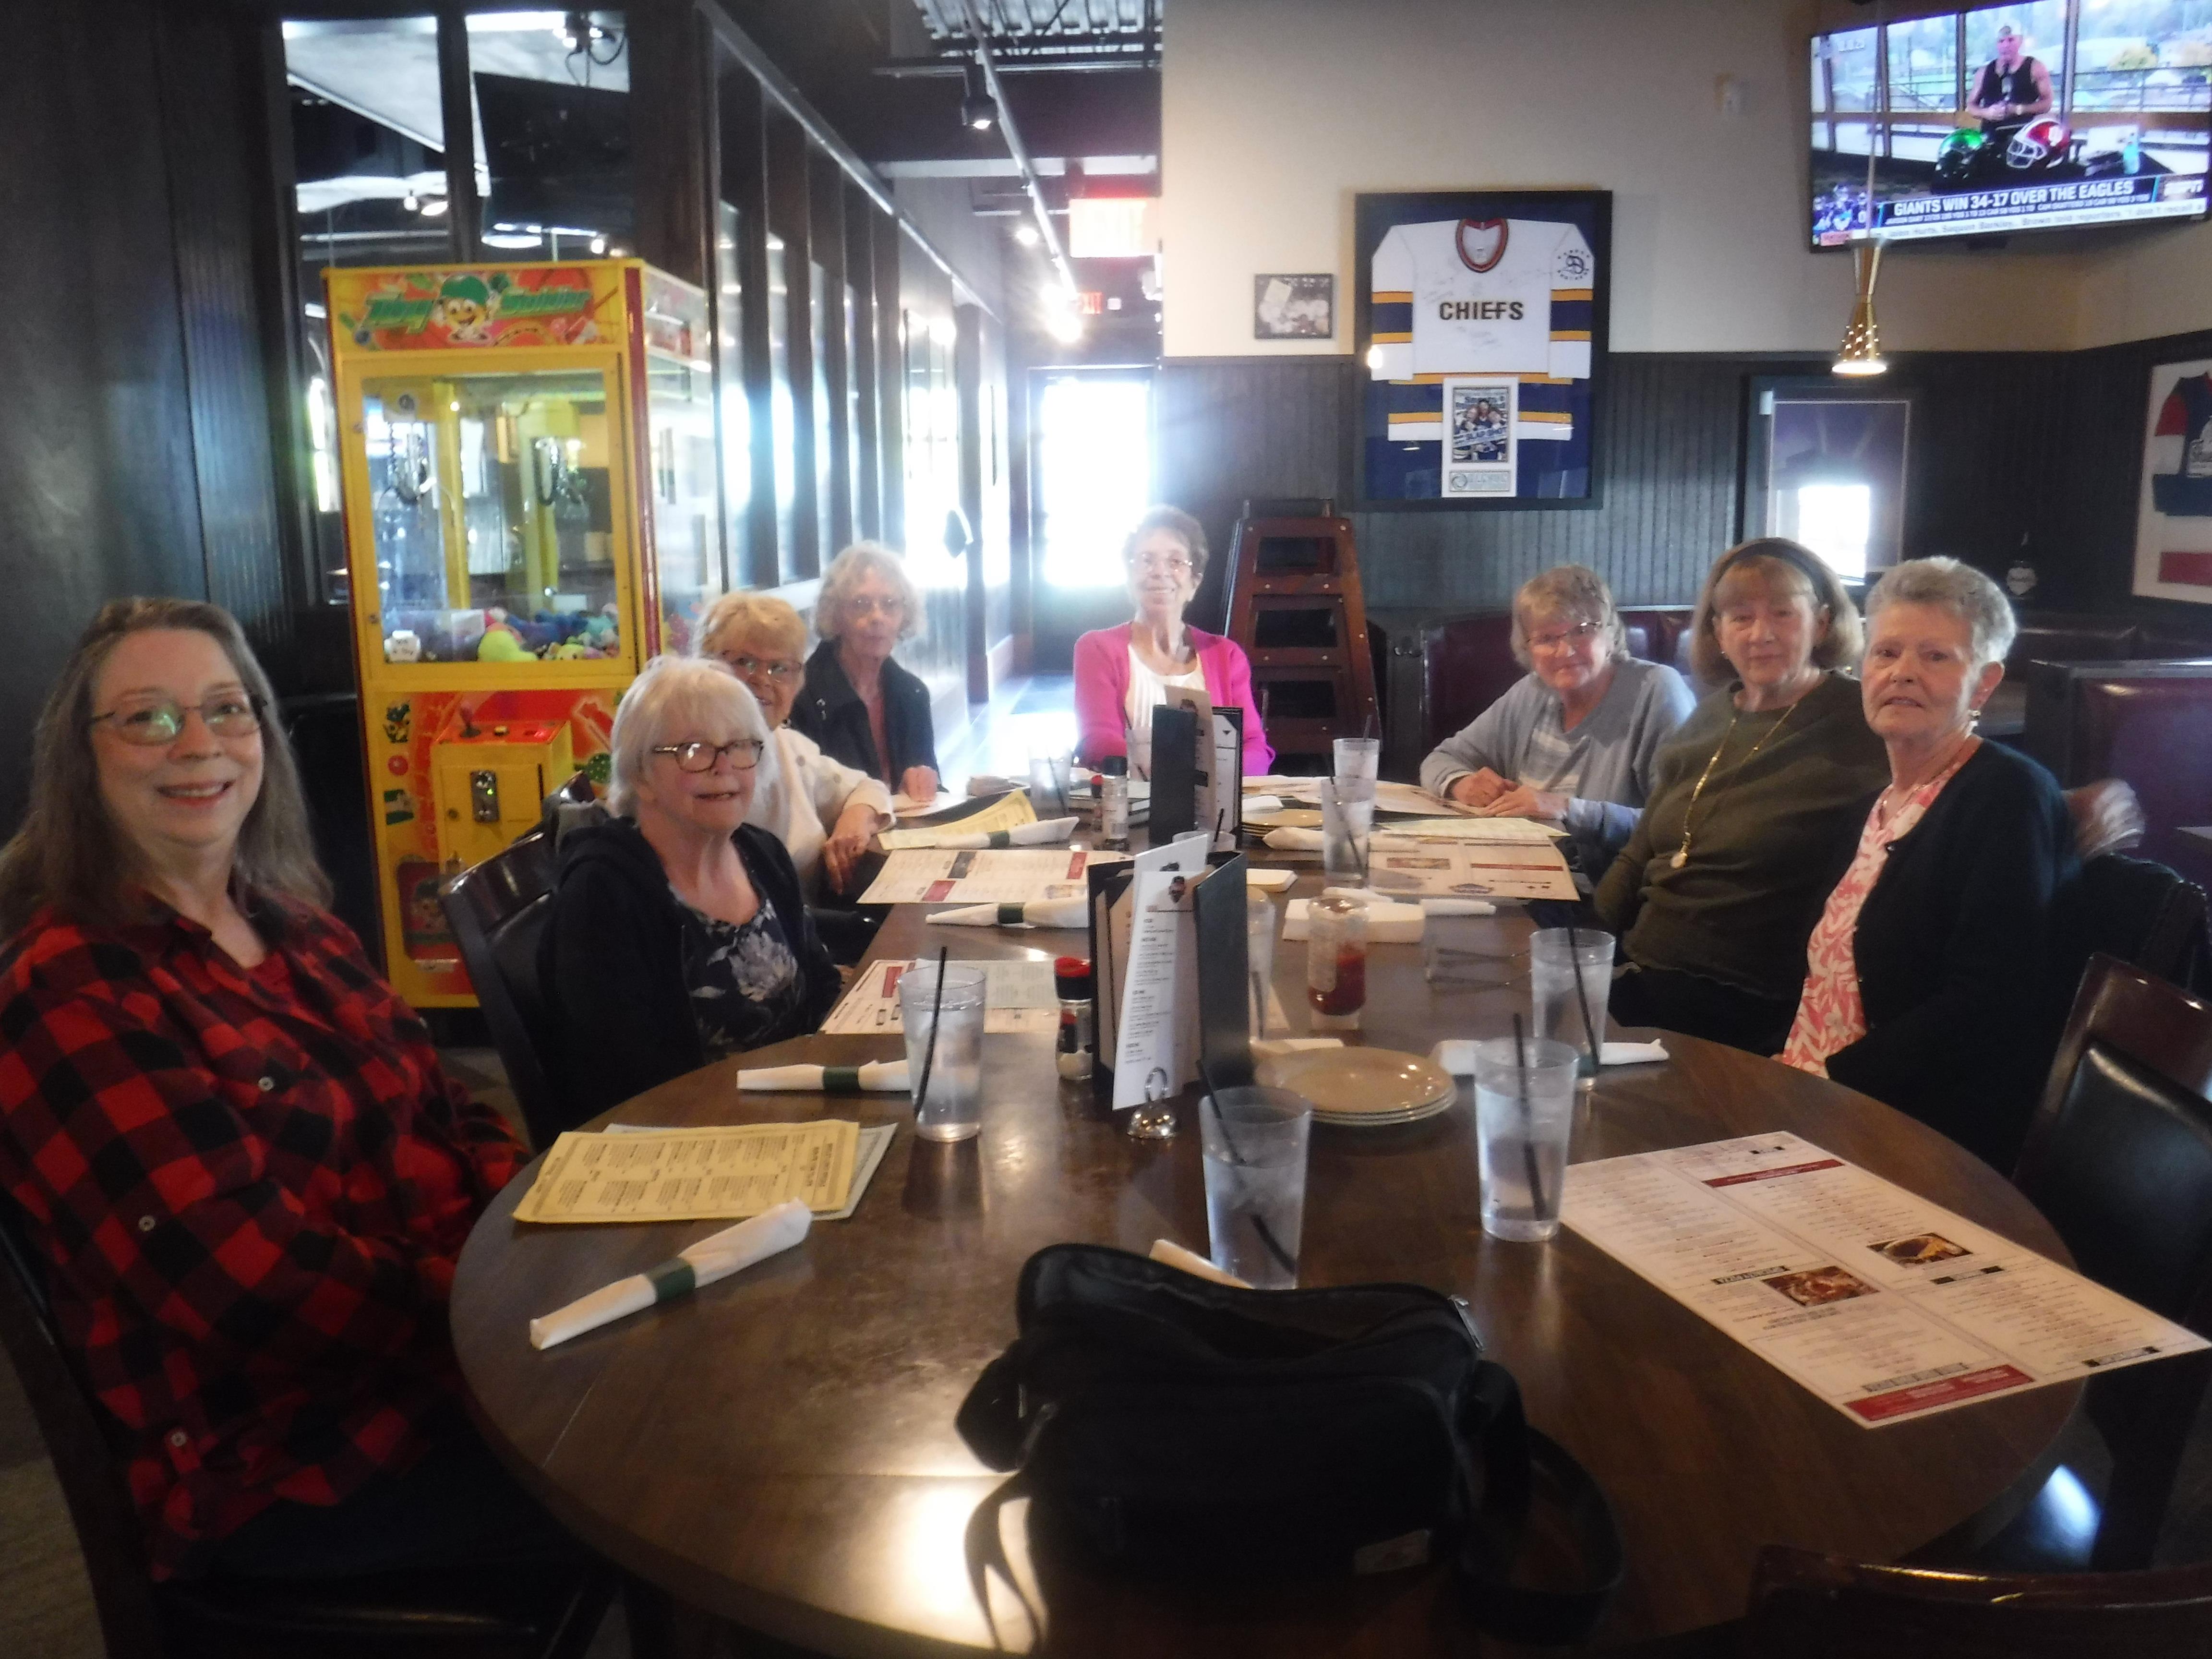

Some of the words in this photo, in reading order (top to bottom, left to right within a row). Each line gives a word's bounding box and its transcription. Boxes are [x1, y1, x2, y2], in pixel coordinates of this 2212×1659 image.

[1894, 199, 1941, 216] GIANTS
[1942, 197, 1968, 212] WIN
[1970, 192, 2008, 209] 34-17
[2010, 189, 2047, 205] OVER
[2049, 186, 2077, 201] THE
[2079, 180, 2134, 199] EAGLES
[1440, 301, 1523, 321] CHIEFS
